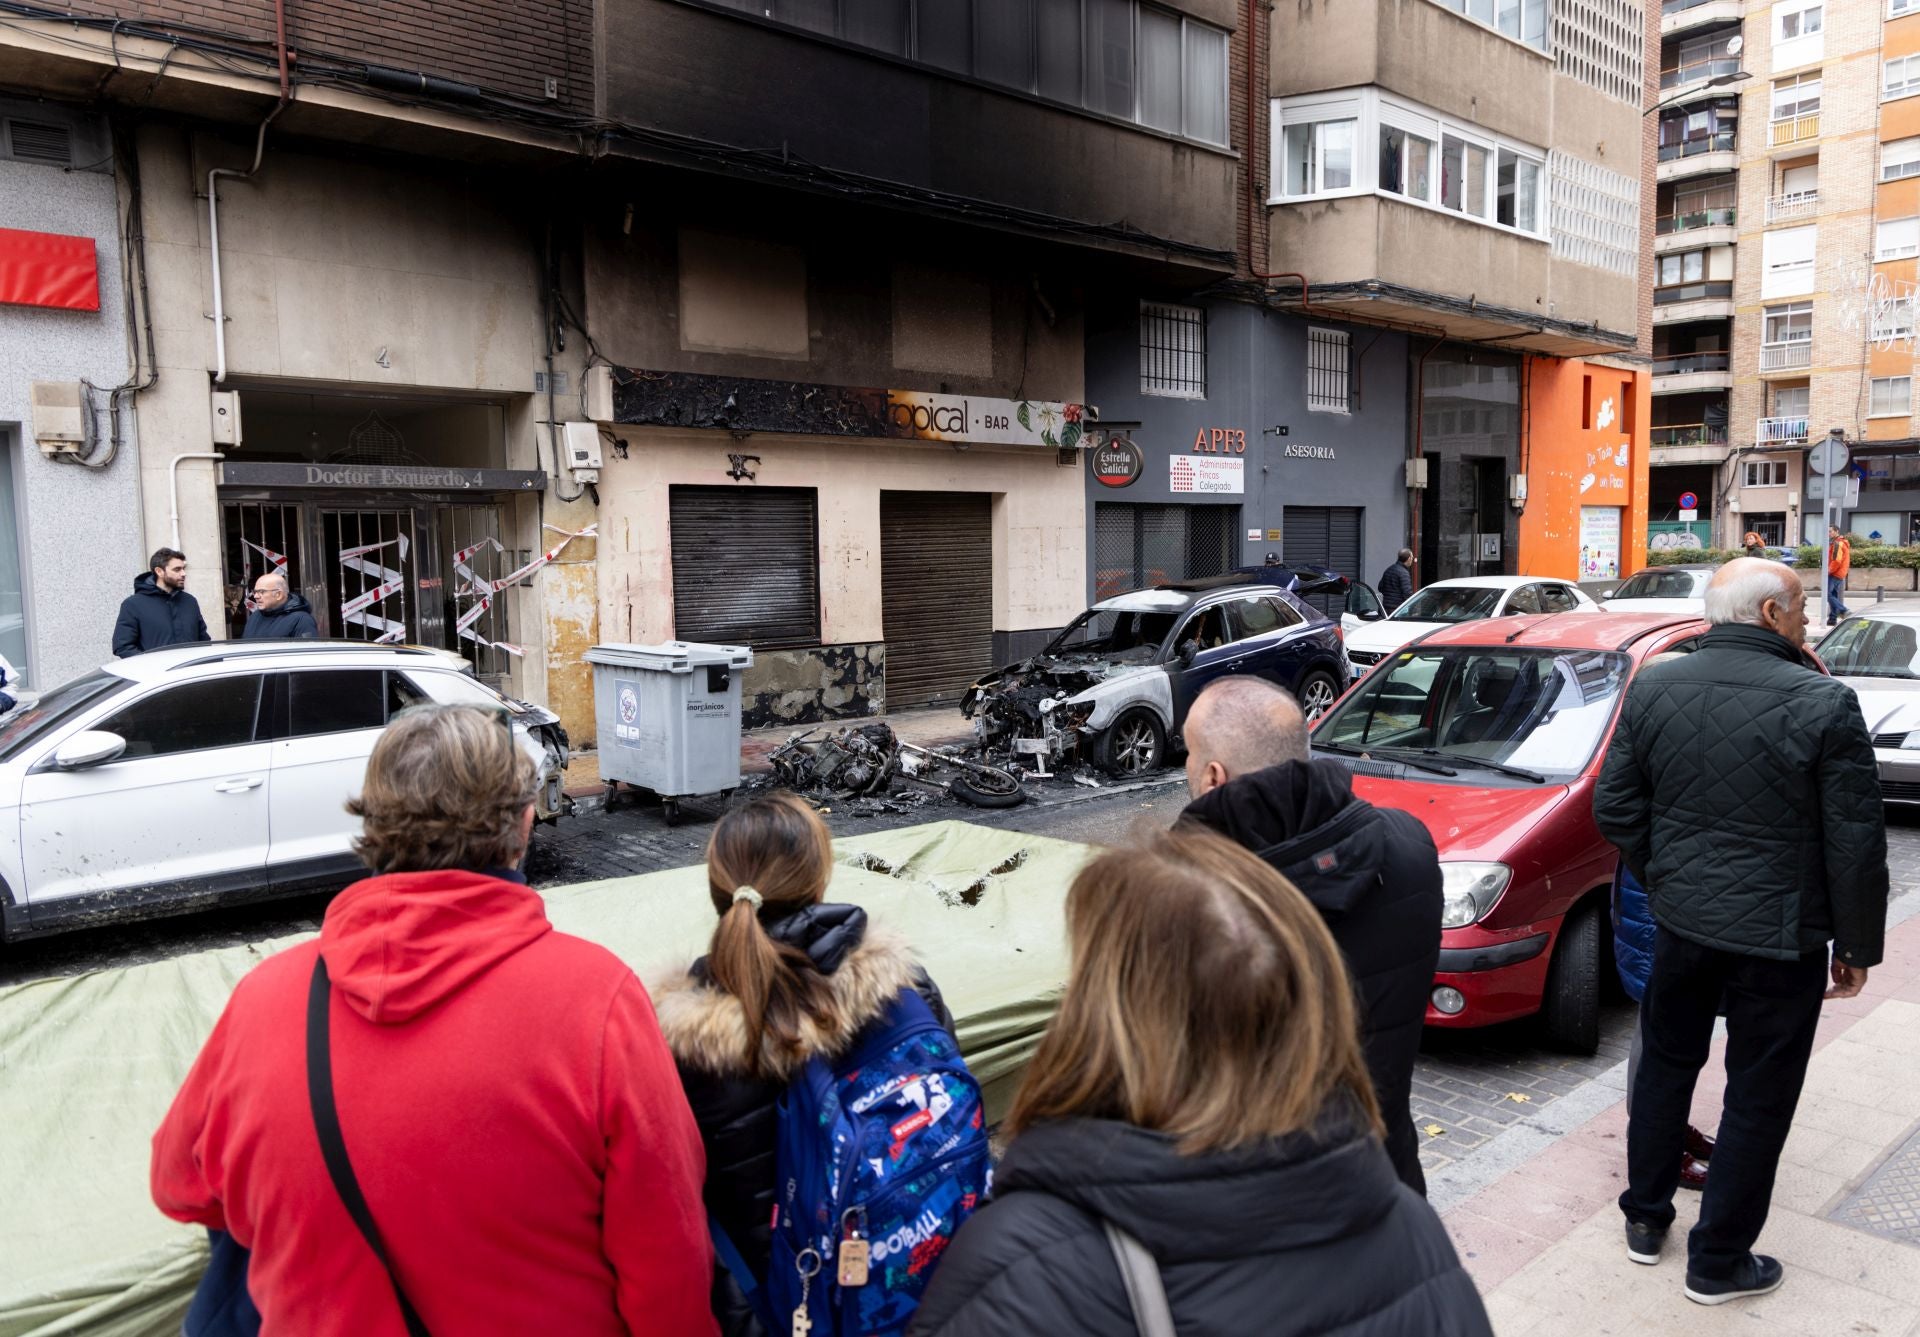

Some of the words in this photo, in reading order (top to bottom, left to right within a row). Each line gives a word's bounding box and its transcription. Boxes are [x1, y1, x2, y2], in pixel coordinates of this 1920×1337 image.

[375, 347, 391, 368] 4
[984, 415, 1010, 430] BAR
[1193, 427, 1246, 453] APF3
[1100, 452, 1131, 463] Estrella
[1284, 444, 1335, 459] ASESORIA
[1101, 463, 1129, 474] Galicia
[1199, 460, 1243, 470] Administrador
[306, 466, 372, 486] Doctor
[473, 471, 484, 487] 4
[1199, 471, 1219, 480] Fincas
[1199, 481, 1232, 492] Colegiado
